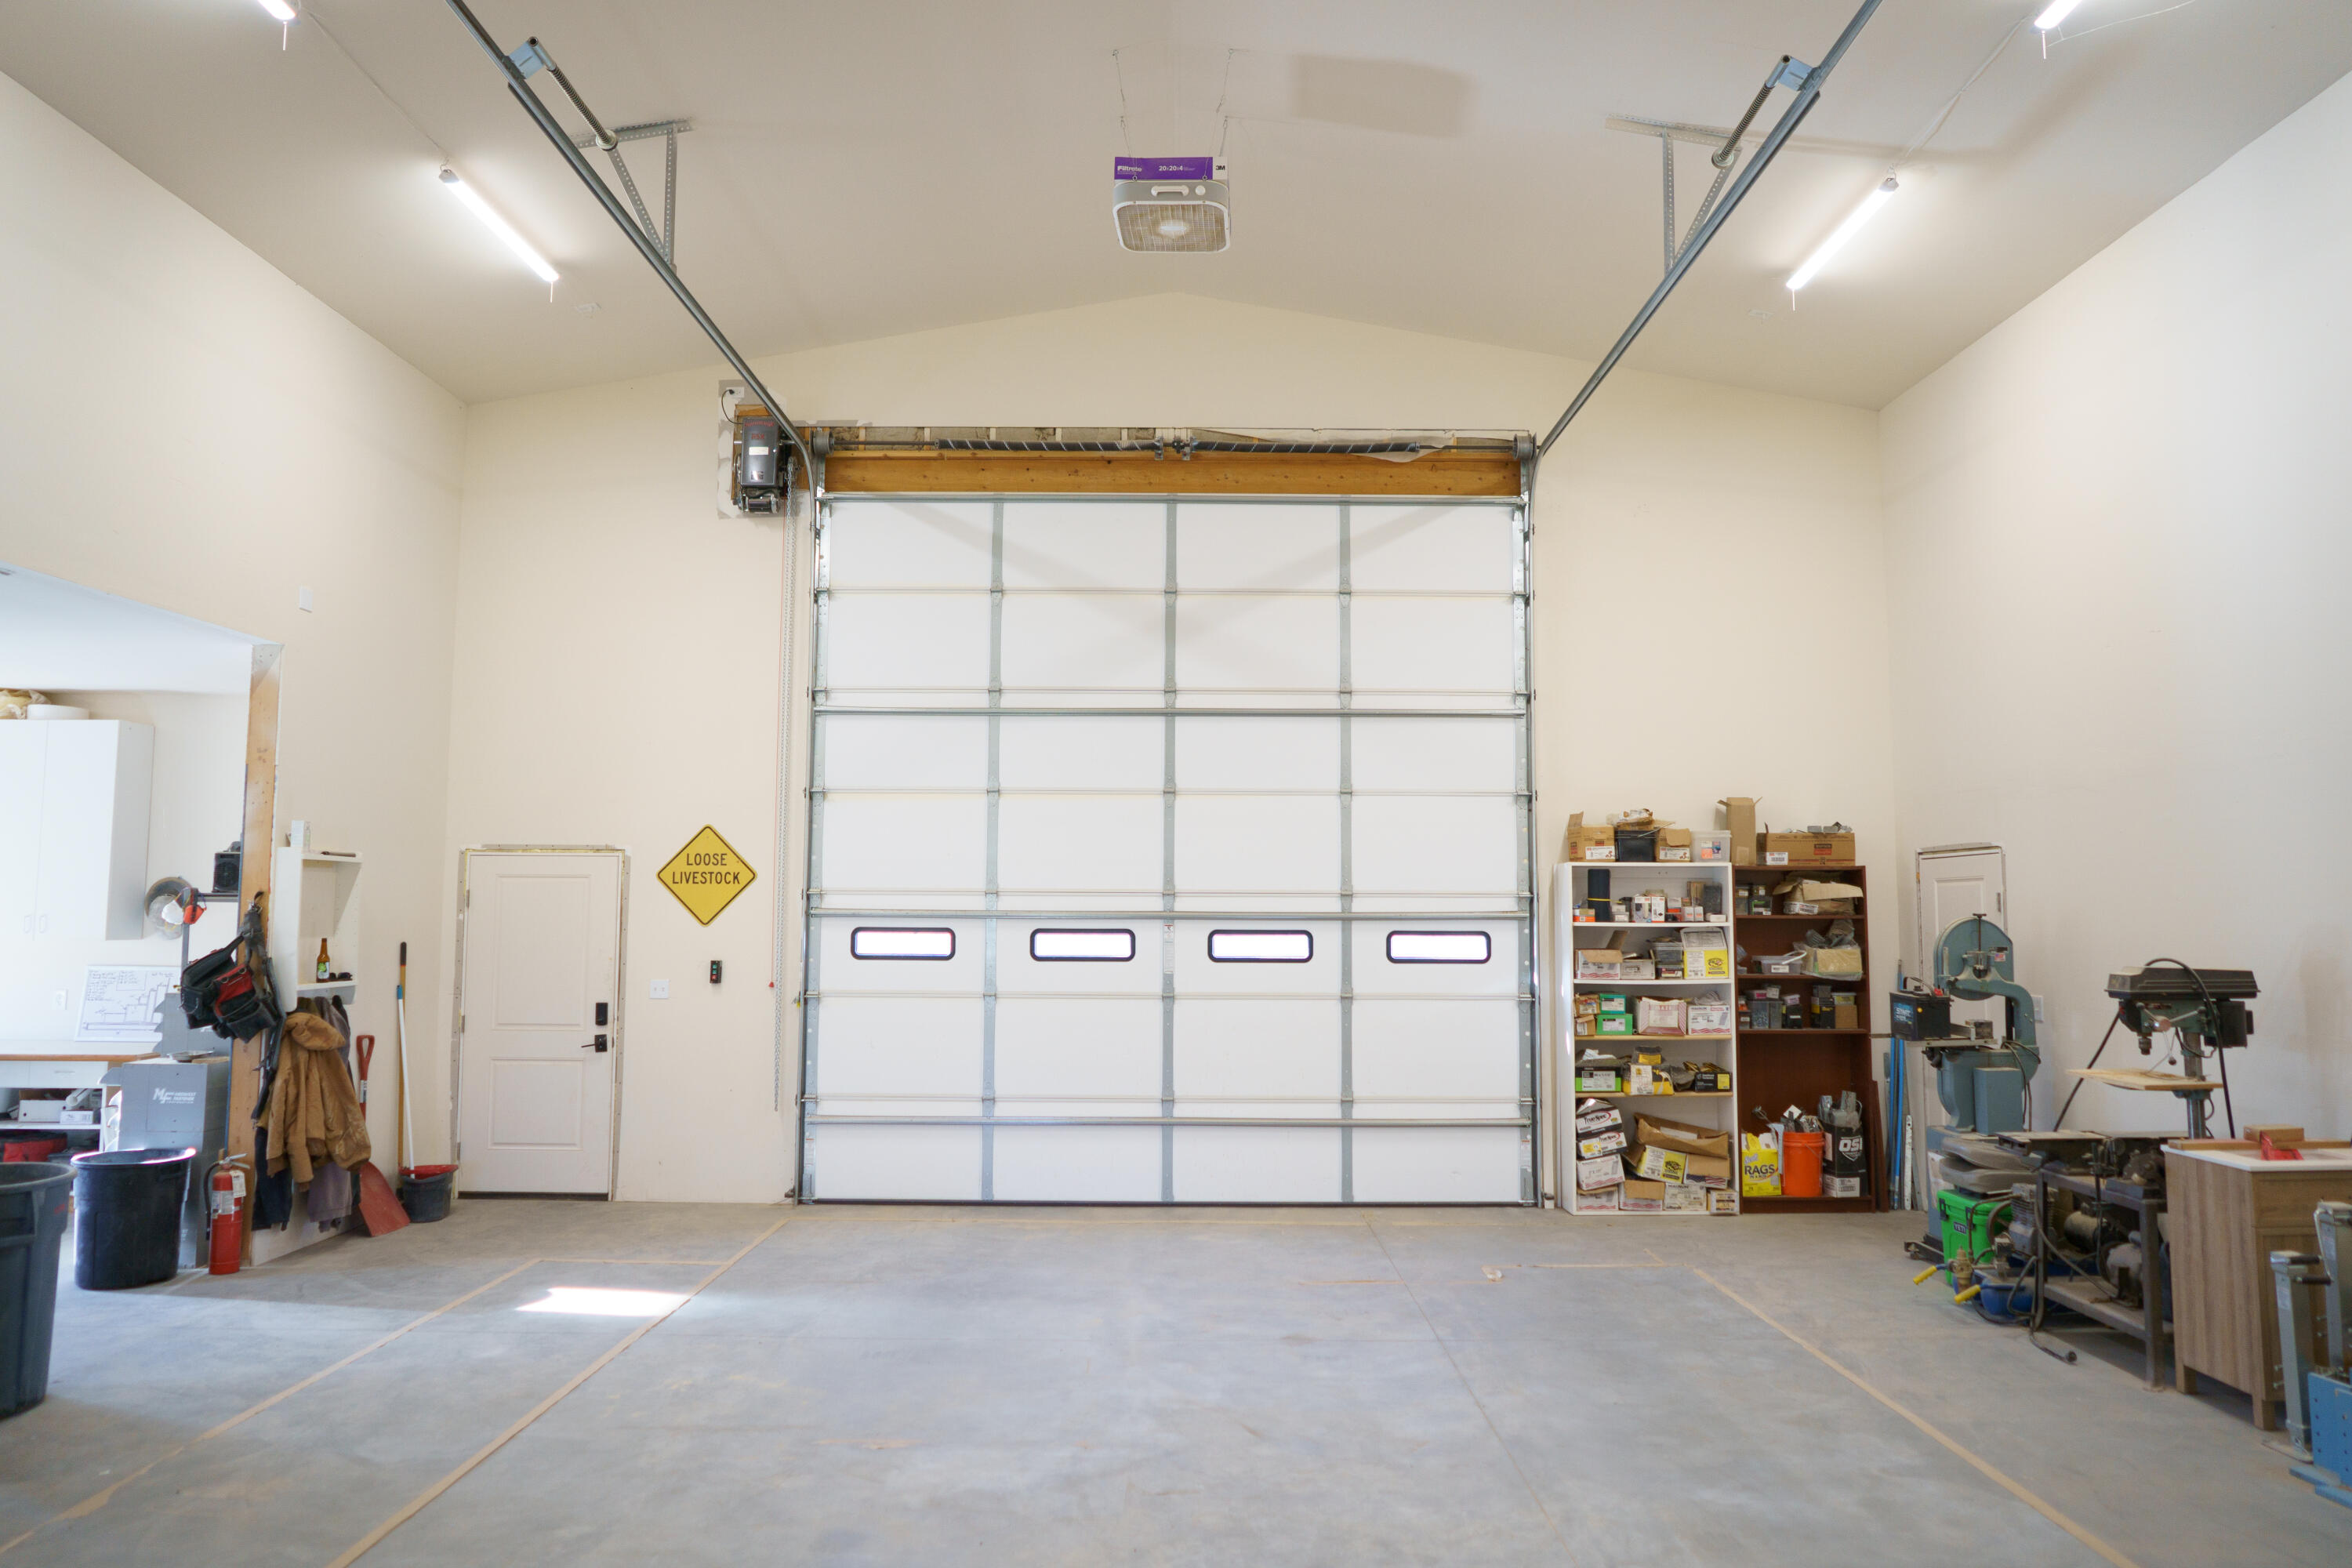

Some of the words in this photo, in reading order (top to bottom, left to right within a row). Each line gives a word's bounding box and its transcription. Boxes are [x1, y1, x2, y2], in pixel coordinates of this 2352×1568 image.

[686, 853, 728, 866] LOOSE
[672, 871, 741, 884] LIVESTOCK
[1744, 1164, 1776, 1175] RAGS
